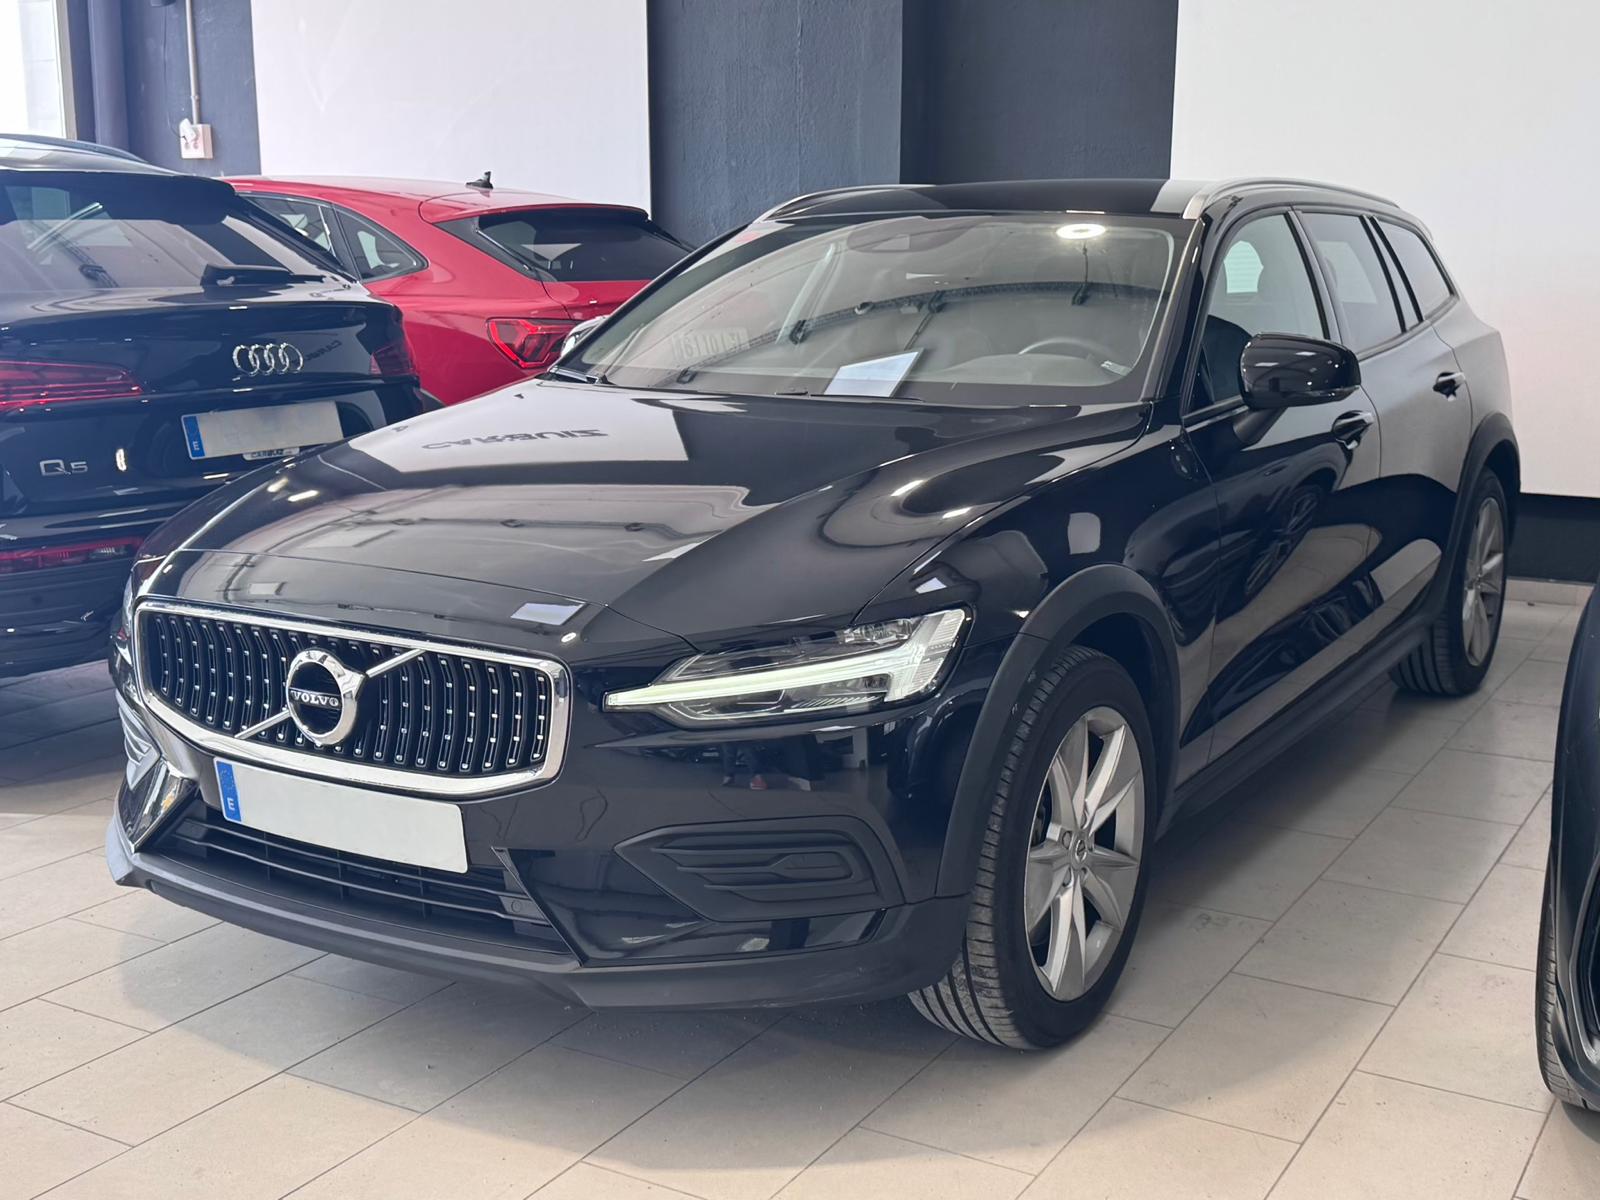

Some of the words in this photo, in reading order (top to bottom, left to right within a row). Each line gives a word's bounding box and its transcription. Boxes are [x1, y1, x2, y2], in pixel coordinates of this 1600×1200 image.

[39, 458, 89, 476] Q5
[291, 690, 339, 706] VOLVO
[226, 797, 236, 811] E
